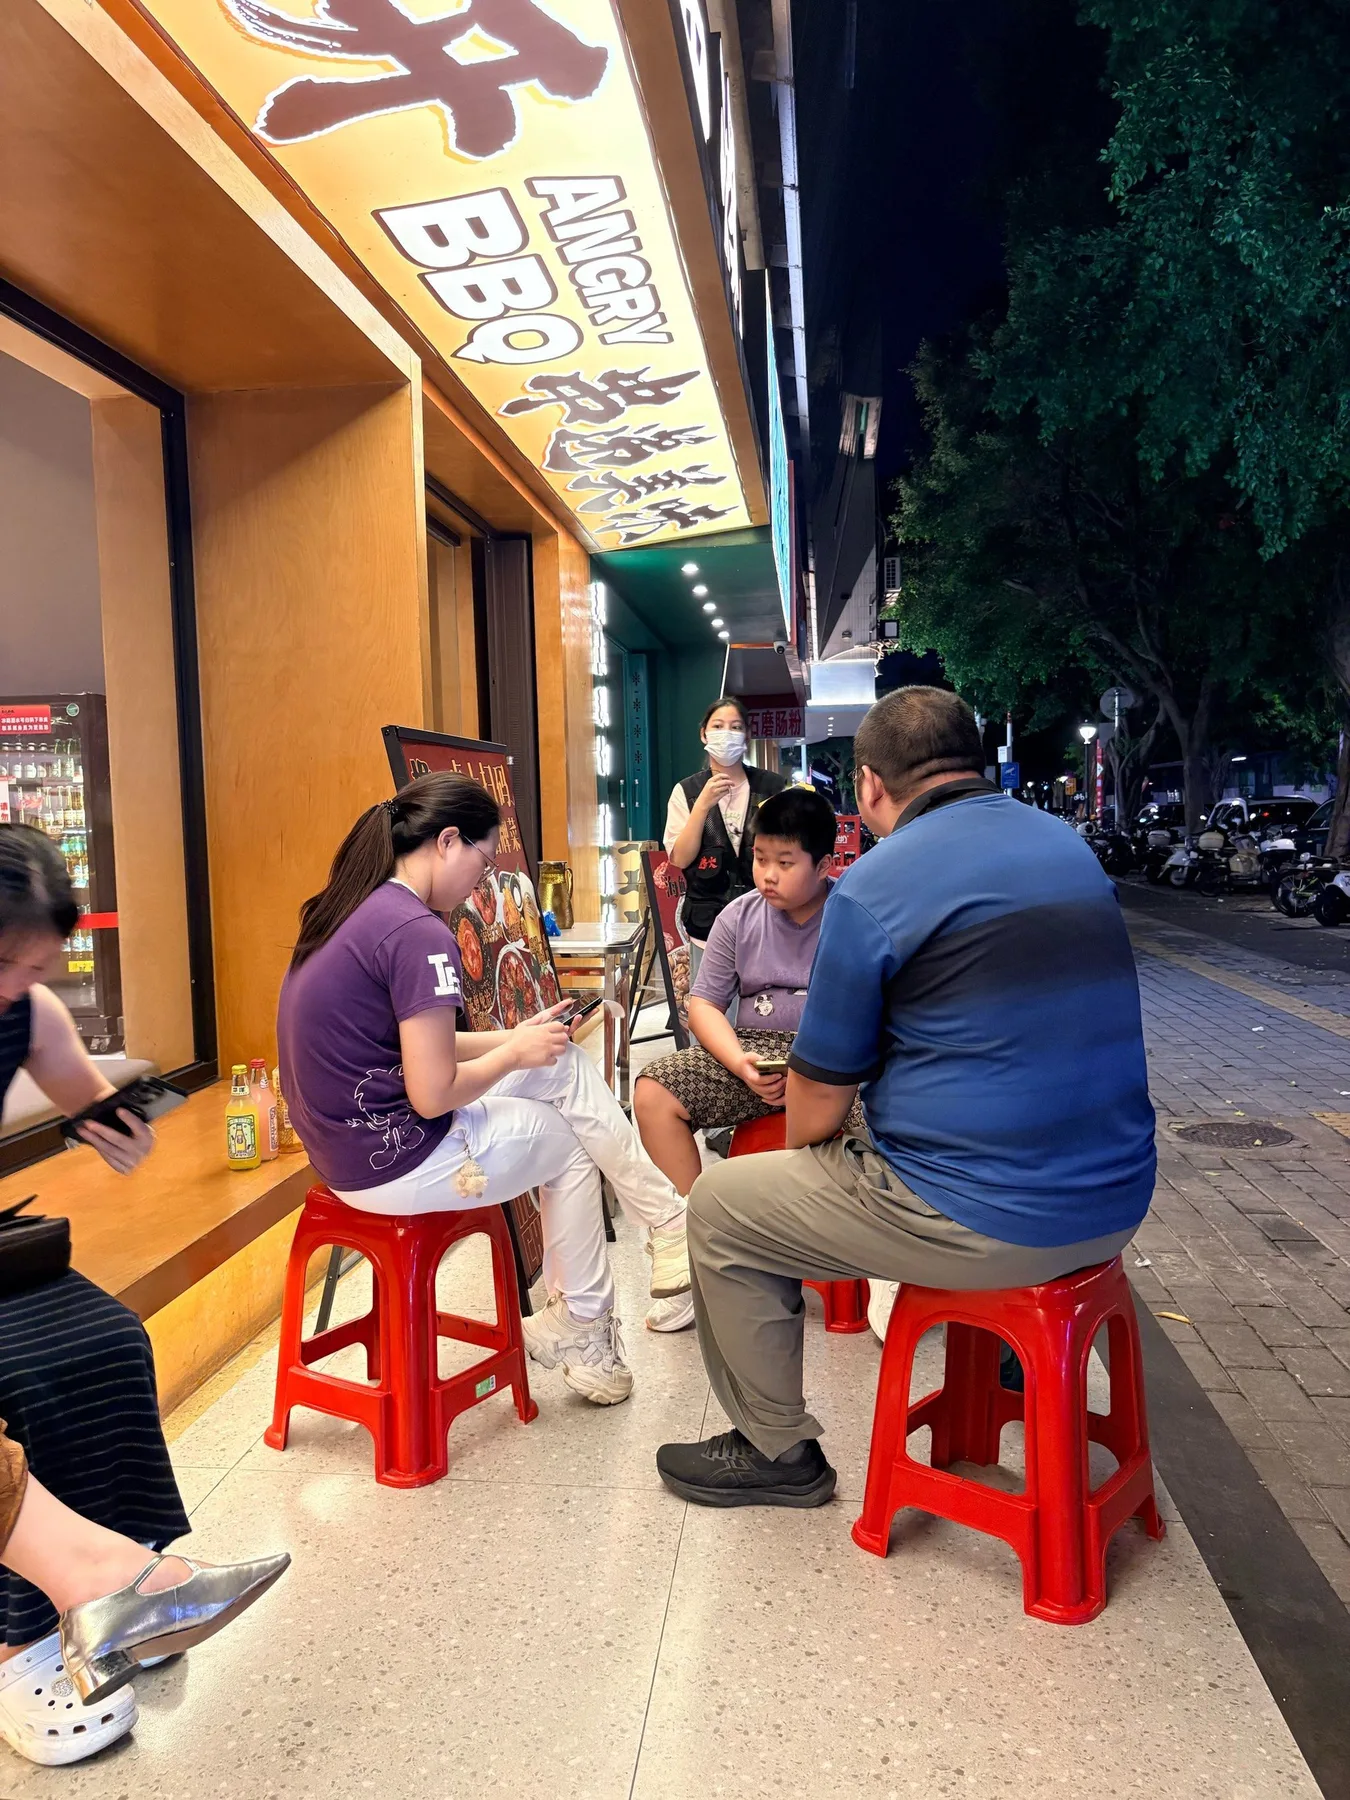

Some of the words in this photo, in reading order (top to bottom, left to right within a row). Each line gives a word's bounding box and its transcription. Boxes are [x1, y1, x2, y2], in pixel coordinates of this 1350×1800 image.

[373, 186, 584, 365] BBQ
[525, 174, 673, 346] ANGRY
[748, 708, 802, 737] 石磨肠粉
